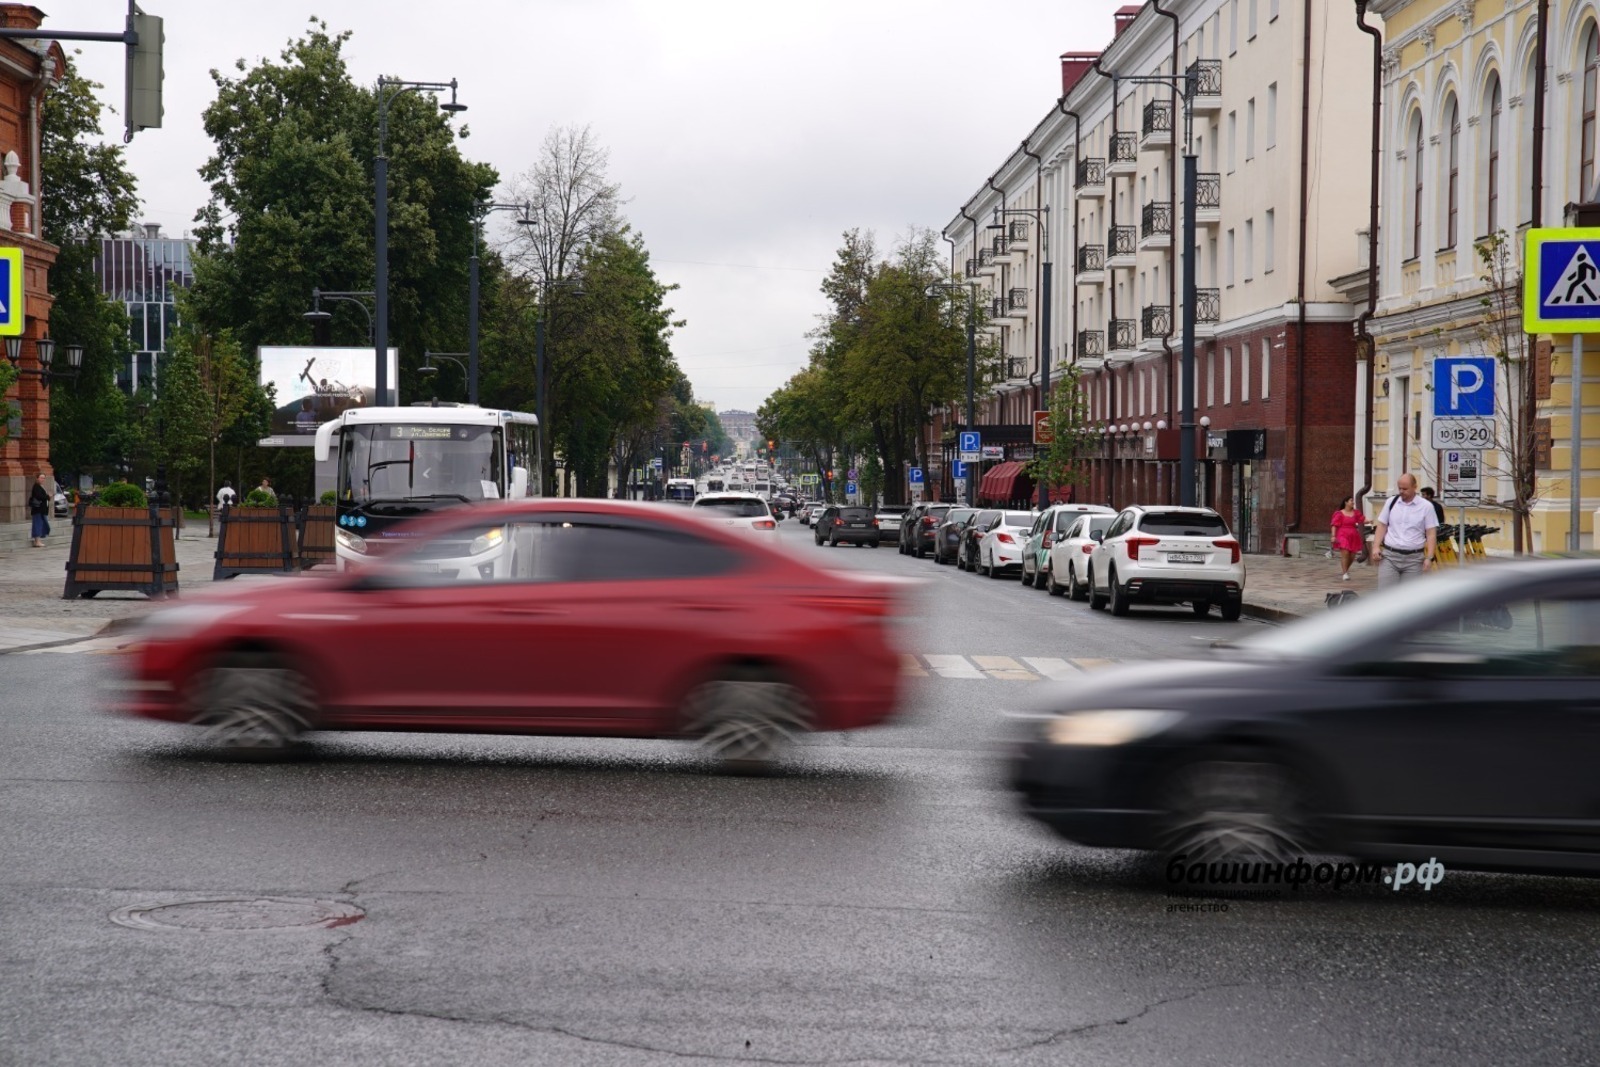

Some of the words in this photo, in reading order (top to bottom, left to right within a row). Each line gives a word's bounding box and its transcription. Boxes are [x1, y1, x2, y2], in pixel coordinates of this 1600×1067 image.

[1451, 364, 1484, 410] P
[397, 427, 403, 437] 3
[1440, 430, 1450, 438] 10
[1453, 429, 1465, 440] 15
[1469, 428, 1488, 441] 20
[964, 434, 975, 449] P
[913, 470, 922, 481] P
